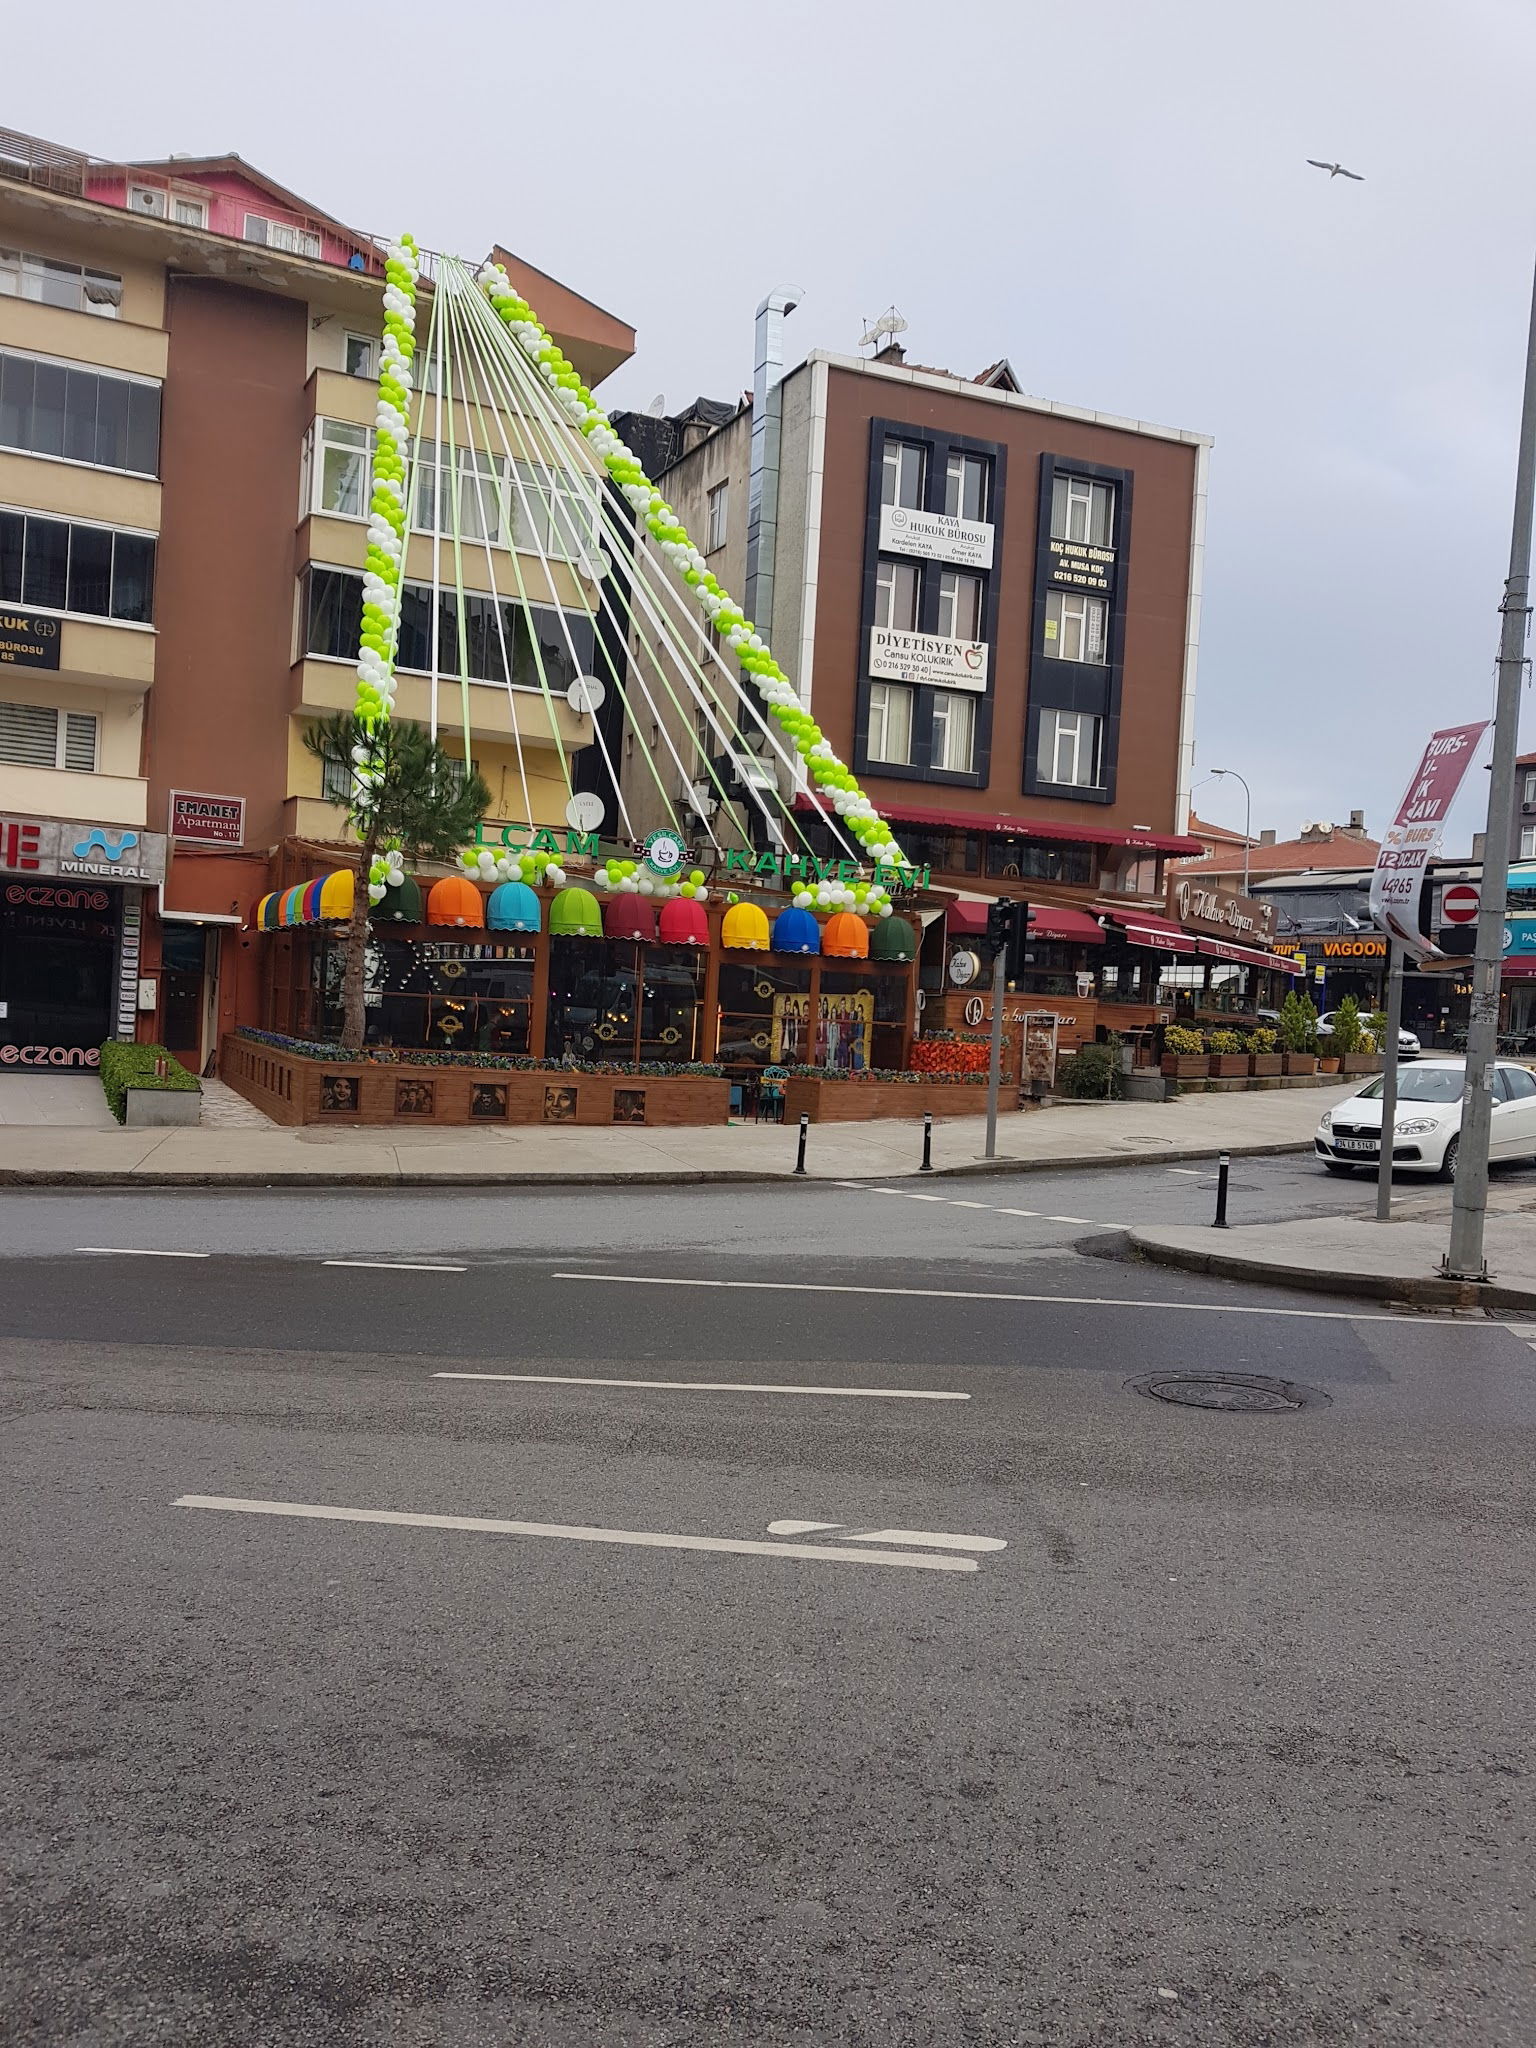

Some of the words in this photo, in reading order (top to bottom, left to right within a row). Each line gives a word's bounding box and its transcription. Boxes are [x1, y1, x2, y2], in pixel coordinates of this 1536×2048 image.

[938, 516, 960, 527] KAYA
[910, 522, 946, 537] HUKUK
[947, 528, 986, 544] BÜROSU
[892, 538, 917, 548] Kardelen
[918, 541, 933, 550] KAYA
[1050, 541, 1064, 555] KOÇ
[1065, 544, 1088, 557] HUKUK
[1088, 547, 1115, 562] BÜROSU
[967, 551, 982, 559] KAYA
[1059, 559, 1070, 568] AV.
[1070, 561, 1090, 572] MUSA
[1091, 564, 1104, 576] KOÇ
[1054, 571, 1072, 581] 0216
[1073, 574, 1087, 584] 520
[1087, 577, 1097, 586] 09
[1097, 579, 1108, 588] 03
[876, 632, 963, 657] DİYETİSYEN
[1, 652, 15, 661] 85
[884, 649, 909, 661] Cansu
[910, 652, 954, 667] KOLUKIRIK
[888, 661, 899, 669] 216
[899, 663, 911, 671] 329
[1427, 734, 1468, 758] BURS-
[176, 800, 239, 819] EMANET
[177, 814, 240, 830] Apartmanı
[475, 823, 601, 857] LÇAM
[1404, 827, 1436, 844] BURS
[61, 859, 151, 879] MİNERAL
[727, 848, 862, 883] KAHVE
[5, 885, 109, 910] eczane
[1323, 942, 1387, 956] VAGOON
[0, 1044, 101, 1066] eczane
